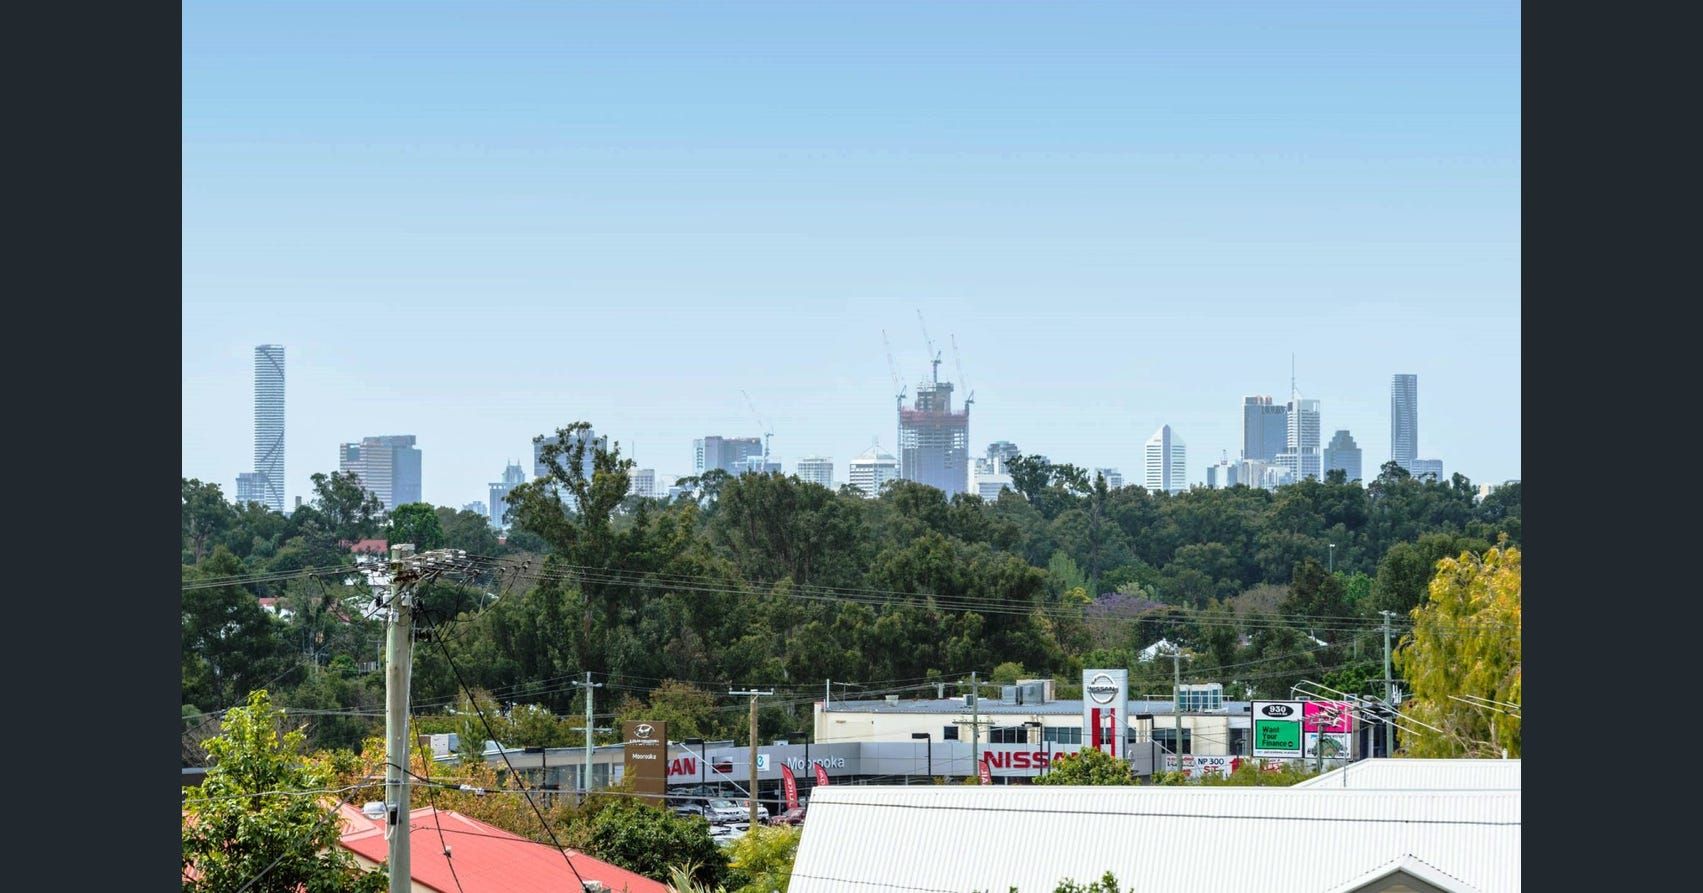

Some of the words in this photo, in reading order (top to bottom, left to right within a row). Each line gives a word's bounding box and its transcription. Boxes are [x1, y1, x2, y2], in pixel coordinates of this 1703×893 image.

[1269, 705, 1287, 713] 930
[983, 751, 1080, 769] NISSA
[1197, 758, 1208, 766] NP
[1209, 758, 1225, 766] 300
